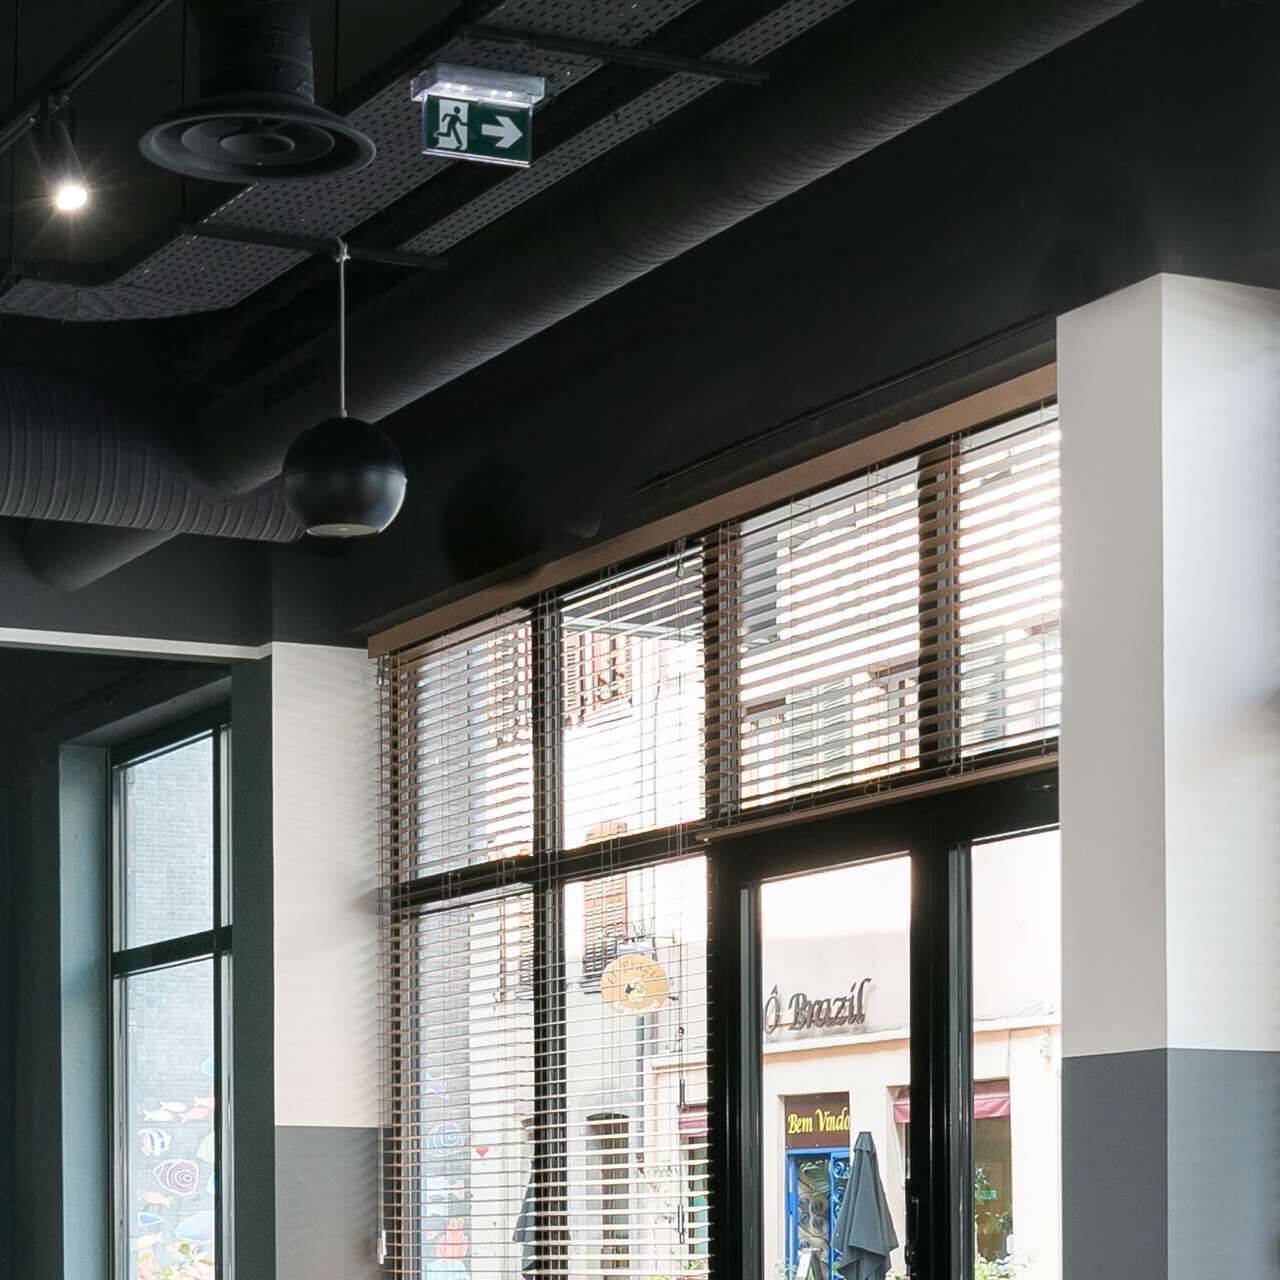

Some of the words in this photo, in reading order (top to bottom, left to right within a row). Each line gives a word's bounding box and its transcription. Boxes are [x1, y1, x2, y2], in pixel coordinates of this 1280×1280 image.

[764, 985, 781, 1034] Ô
[788, 977, 871, 1031] Brazil
[787, 1115, 813, 1134] Bem
